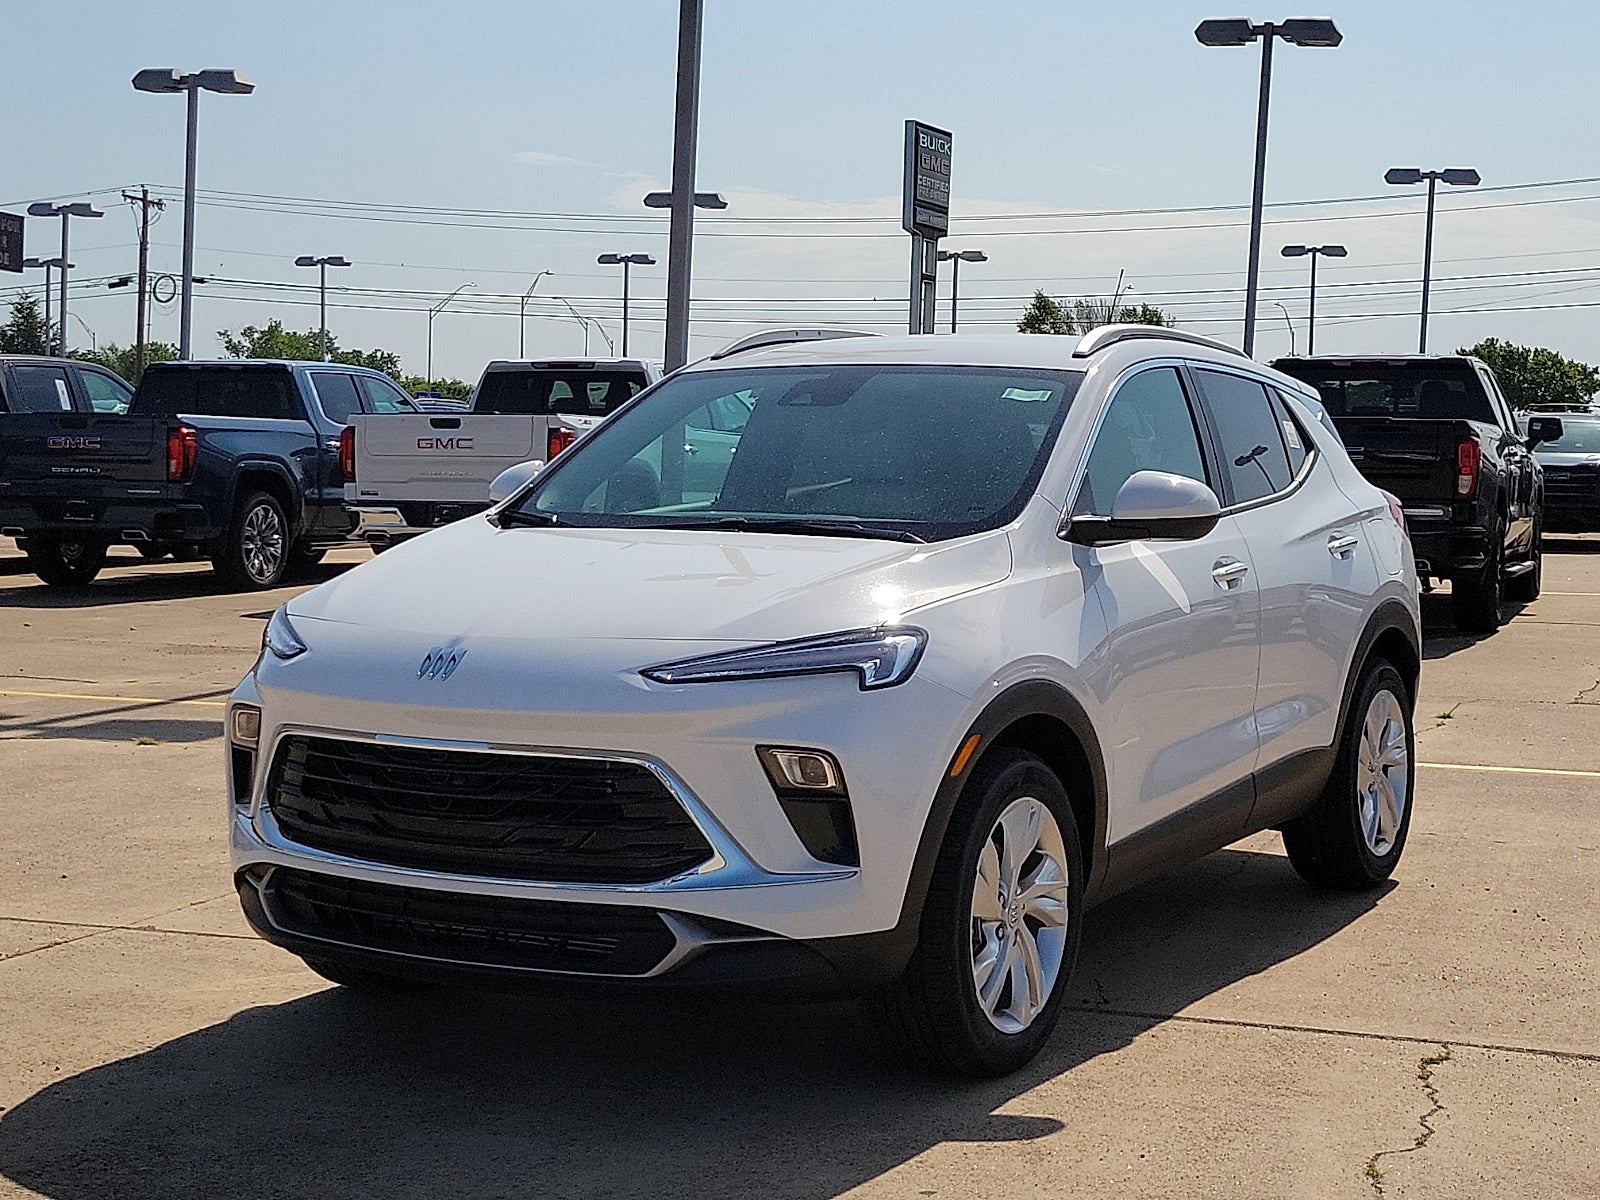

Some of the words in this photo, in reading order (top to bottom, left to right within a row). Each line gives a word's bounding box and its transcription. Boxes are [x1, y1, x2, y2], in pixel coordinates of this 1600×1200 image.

[920, 133, 951, 155] BUICK
[921, 153, 949, 175] GMC
[918, 175, 949, 193] CERTIFIED
[47, 436, 101, 449] GMC
[416, 437, 474, 450] GMC
[51, 466, 101, 474] DENALI
